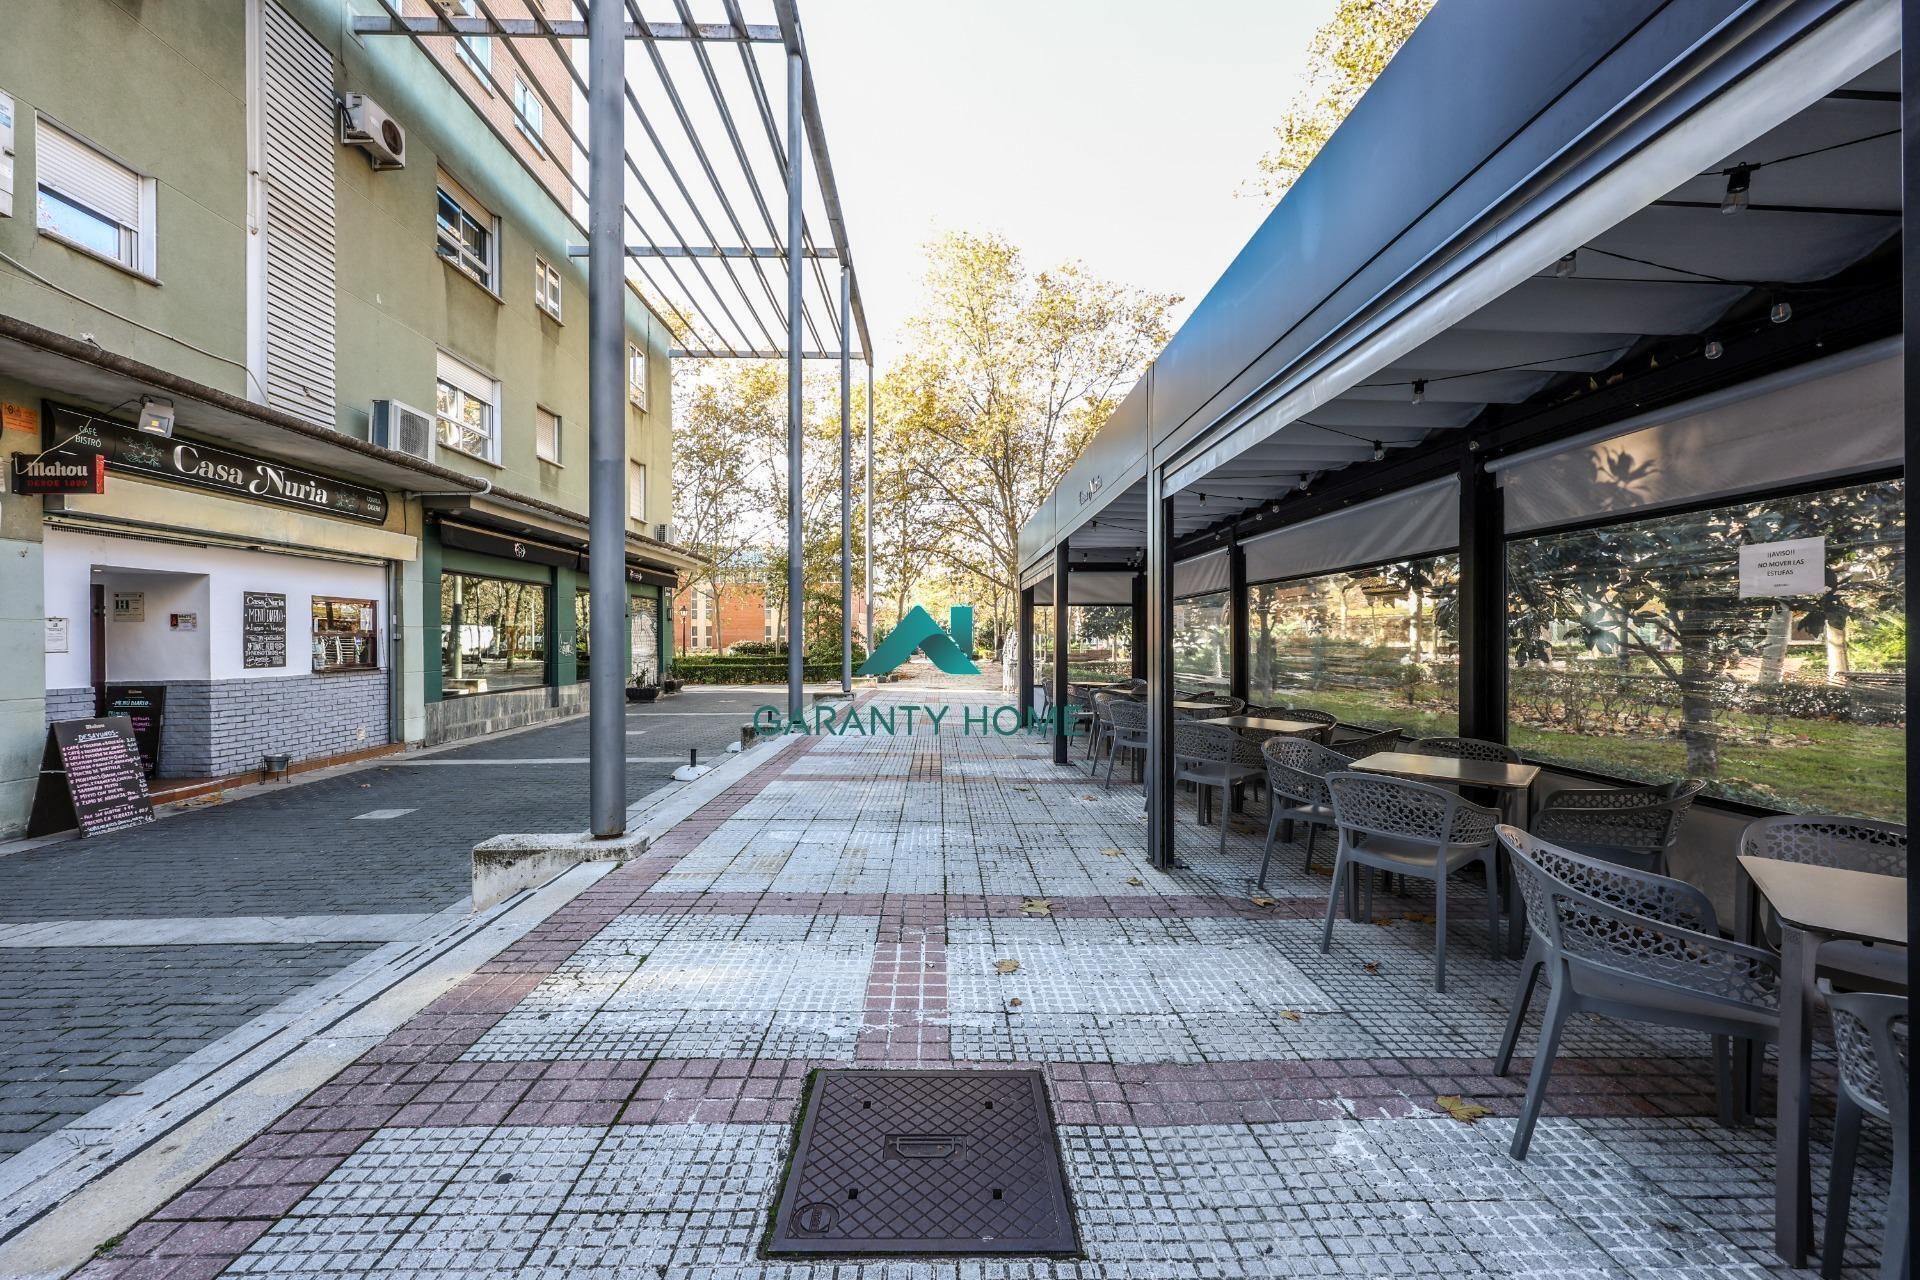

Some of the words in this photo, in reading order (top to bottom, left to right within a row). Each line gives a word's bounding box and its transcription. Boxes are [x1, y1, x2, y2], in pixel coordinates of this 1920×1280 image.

[27, 462, 88, 476] Mahou
[173, 445, 243, 485] Casa
[249, 465, 328, 504] Nuria
[247, 597, 264, 605] Casa
[264, 598, 284, 608] Nuria
